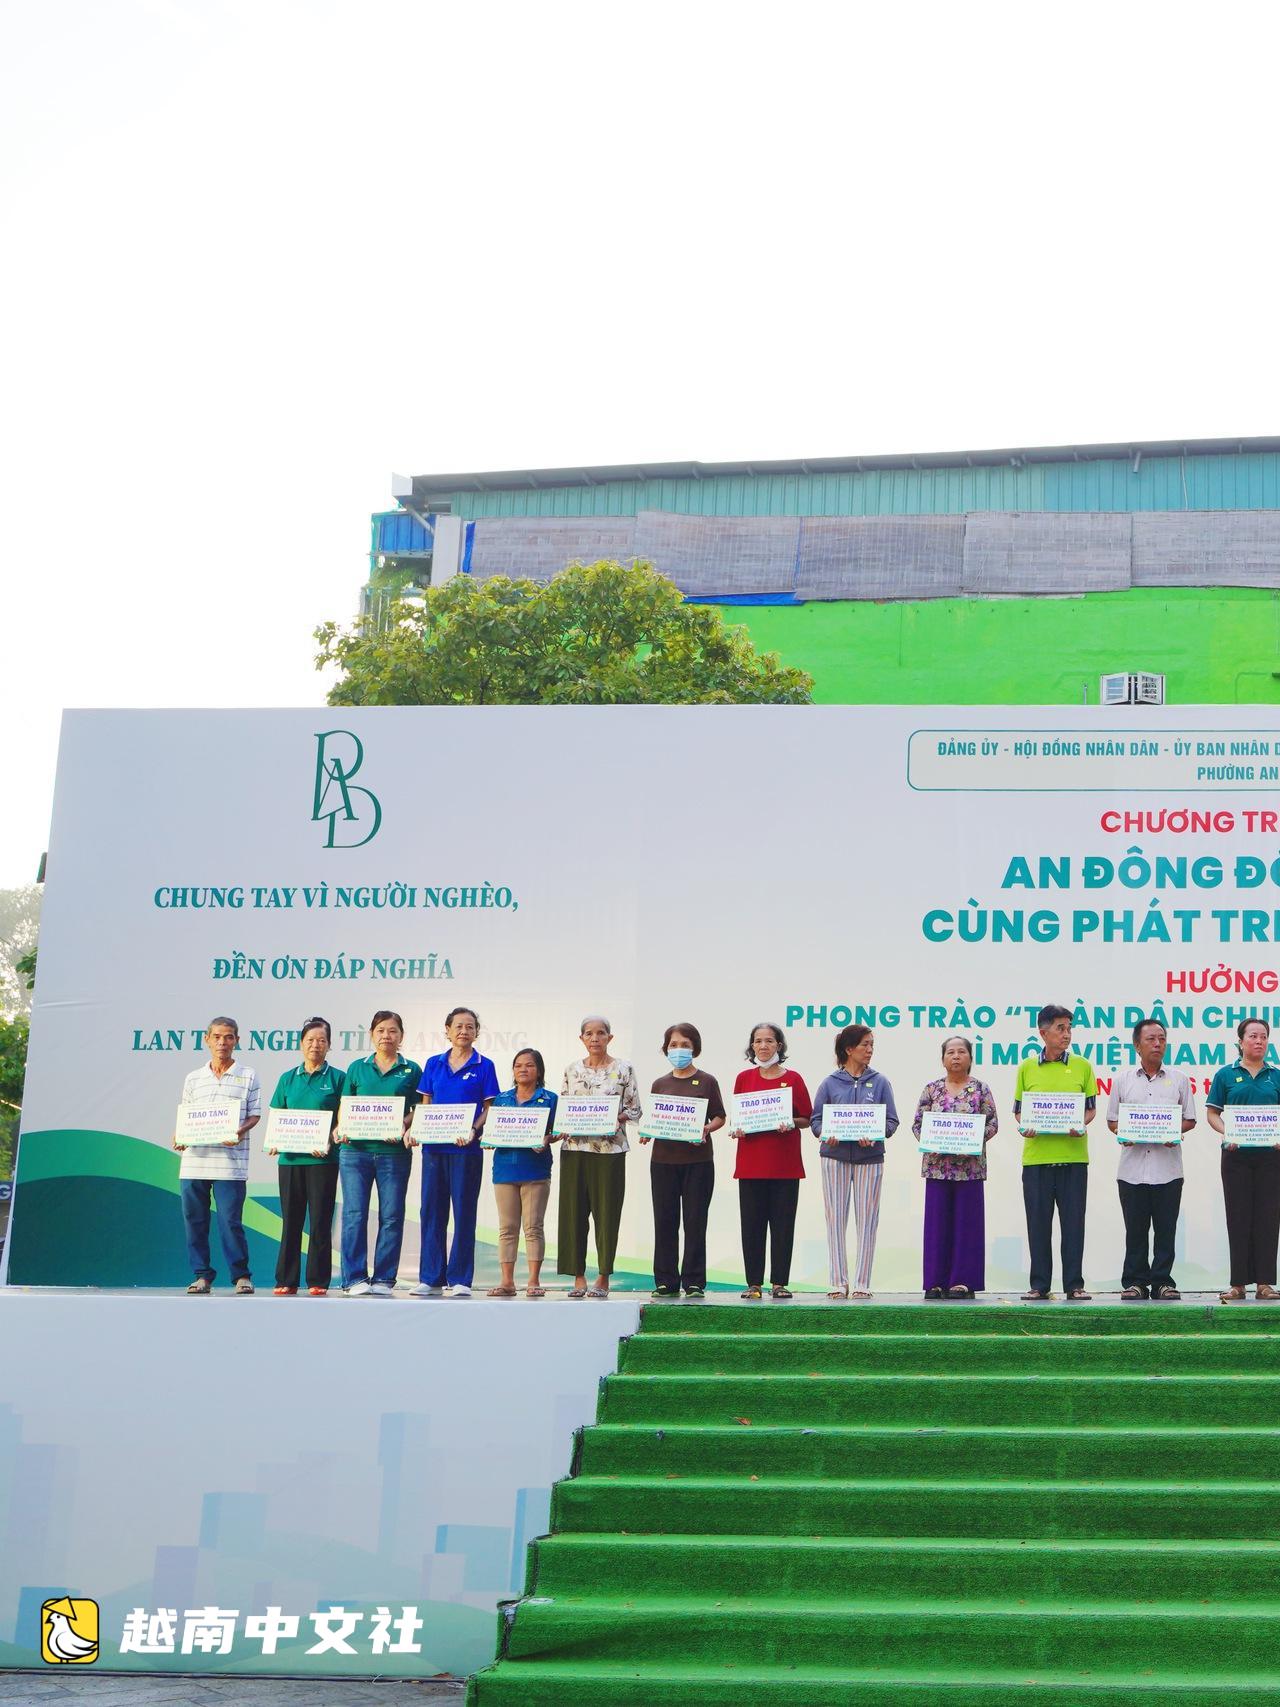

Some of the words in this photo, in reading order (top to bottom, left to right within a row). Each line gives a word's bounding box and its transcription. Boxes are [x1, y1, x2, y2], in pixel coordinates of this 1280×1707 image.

[938, 738, 976, 757] ĐẢNG
[981, 738, 998, 757] ỦY
[1014, 739, 1037, 759] HỘI
[1042, 738, 1080, 757] ĐỒNG
[1086, 740, 1126, 756] NHÂN
[1130, 740, 1158, 756] DÂN
[1174, 738, 1191, 757] ỦY
[1197, 742, 1226, 756] BAN
[1231, 740, 1269, 756] NHÂN
[1197, 764, 1254, 780] PHƯỜNG
[1260, 767, 1278, 780] AN
[1101, 808, 1234, 832] CHƯƠNG
[1000, 855, 1072, 890] AN
[1081, 845, 1224, 890] ĐÔNG
[152, 886, 245, 910] CHUNG
[250, 886, 298, 910] TAY
[300, 881, 329, 909] VÌ
[335, 881, 417, 910] NGƯỜI
[423, 881, 519, 912] NGHÈO,
[921, 897, 1061, 944] CÙNG
[1071, 897, 1202, 944] PHÁT
[213, 951, 265, 980] ĐỀN
[271, 951, 308, 980] ƠN
[314, 951, 364, 980] ĐÁP
[371, 951, 454, 980] NGHĨA
[1167, 964, 1278, 993] HƯỞNG
[786, 1005, 900, 1028] PHONG
[908, 998, 996, 1028] TRÀO
[1005, 998, 1115, 1028] “TÀN
[1124, 1000, 1193, 1028] DÂN
[132, 1030, 185, 1051] LAN
[1076, 1036, 1138, 1072] VIỆT
[655, 1103, 674, 1112] TRAO
